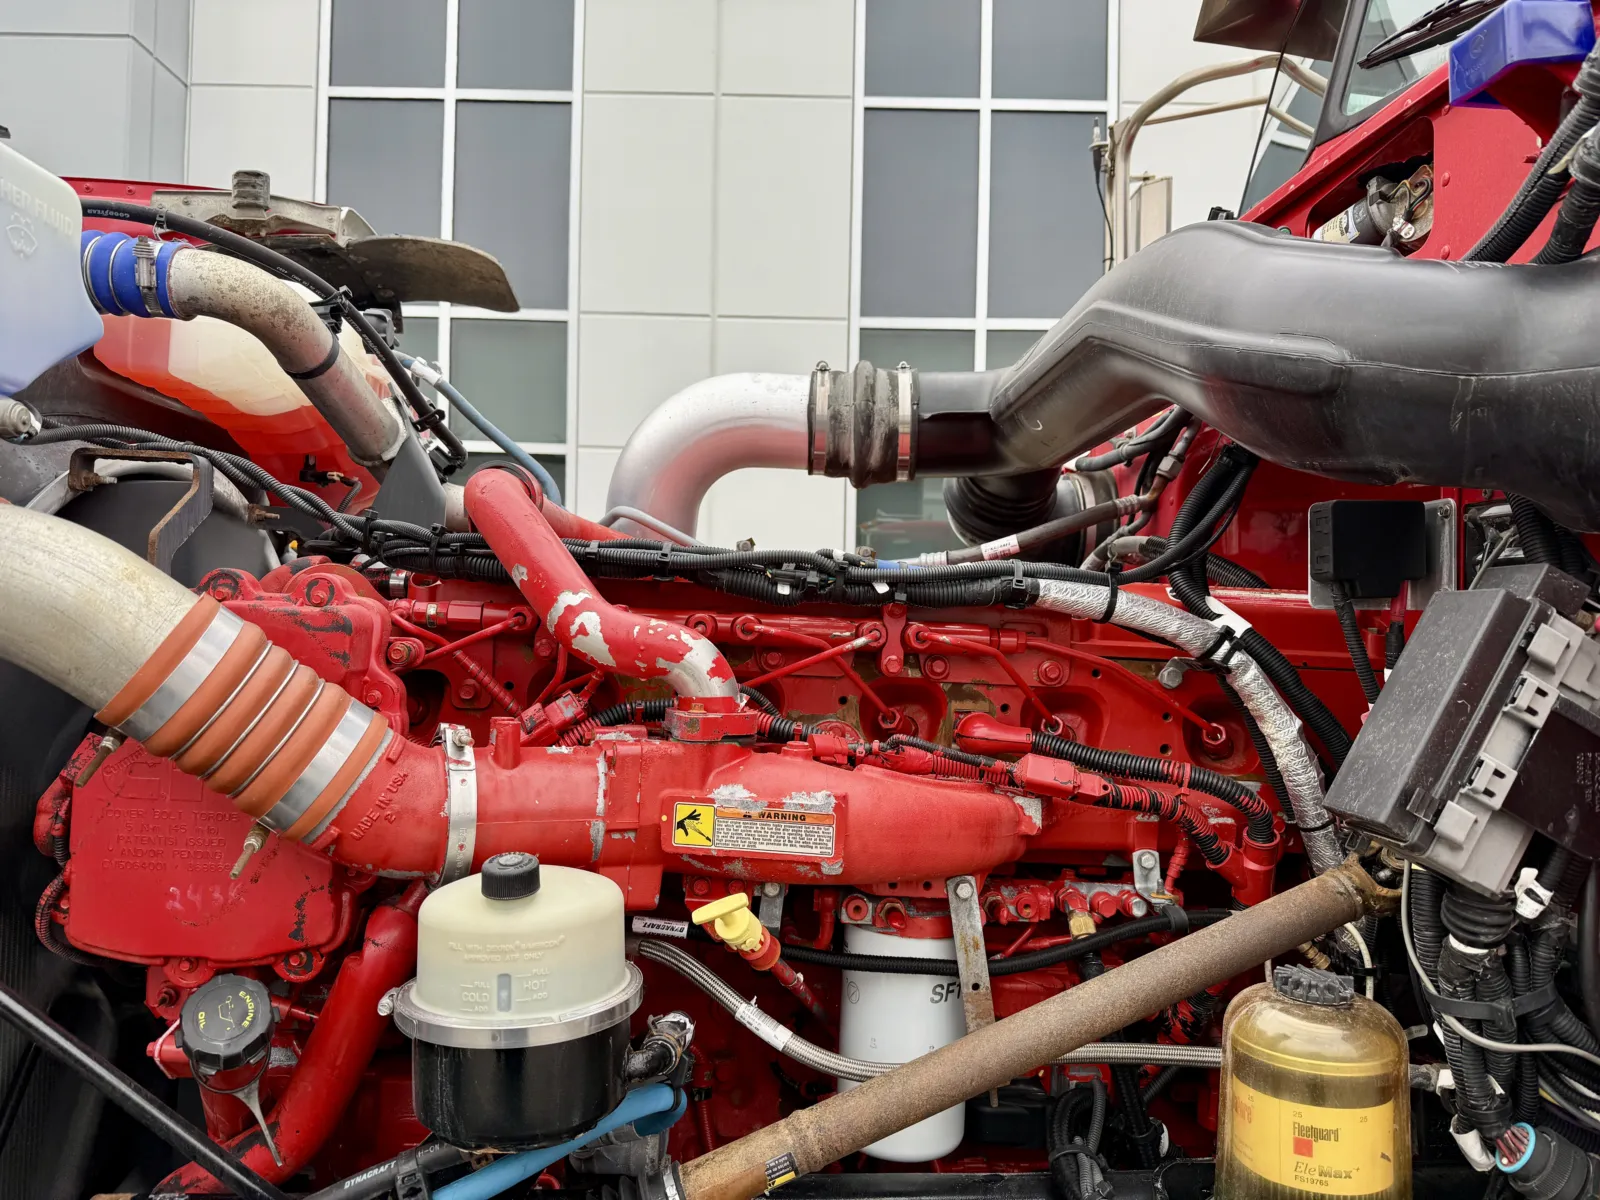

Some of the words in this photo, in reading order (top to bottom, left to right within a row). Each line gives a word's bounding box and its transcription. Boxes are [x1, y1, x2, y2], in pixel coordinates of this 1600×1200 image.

[34, 197, 73, 236] FLUID
[87, 208, 130, 218] GOODYEAR
[349, 808, 380, 842] MADE
[375, 792, 393, 810] IN
[386, 771, 409, 794] USA
[105, 808, 145, 819] COVER
[153, 809, 183, 820] BOLT
[192, 810, 240, 822] TORQUE
[758, 811, 806, 822] WARNING
[125, 820, 133, 832] 5
[116, 834, 178, 845] PATENT(S)
[185, 836, 226, 847] ISSUED
[120, 848, 164, 858] AND/OR
[172, 849, 224, 860] PENDING
[643, 921, 685, 933] DYNACRAFT
[464, 953, 501, 962] APPROVED
[524, 951, 544, 961] ONLY
[531, 967, 551, 976] FULL
[473, 981, 491, 989] FULL
[523, 978, 547, 991] HOT
[461, 991, 490, 1002] COLD
[532, 991, 549, 1000] ADD
[239, 990, 255, 1028] ENGINE
[198, 1011, 206, 1029] OIL
[1292, 1110, 1303, 1118] 25
[1292, 1121, 1340, 1143] Fleetguard
[344, 1160, 397, 1190] DYNACRAFT
[1294, 1174, 1329, 1187] FS19765
